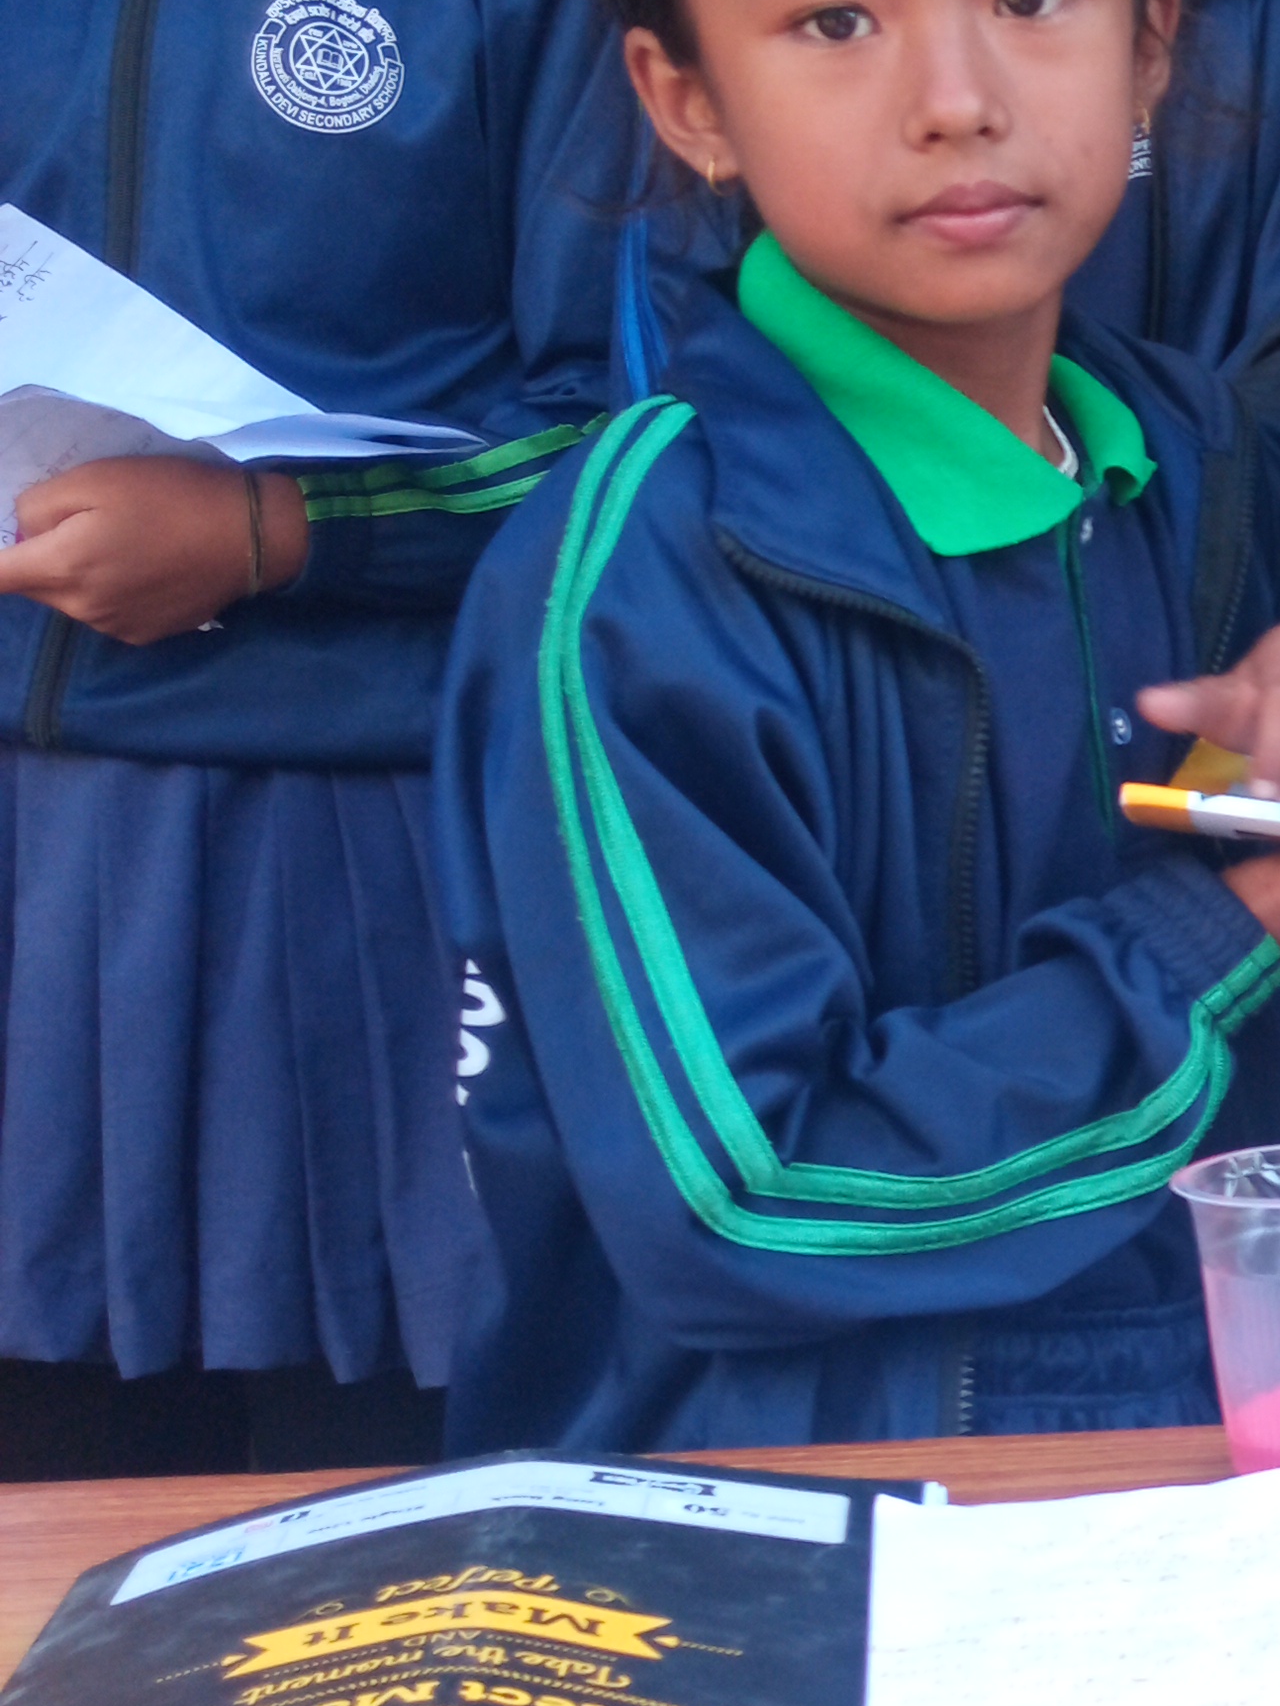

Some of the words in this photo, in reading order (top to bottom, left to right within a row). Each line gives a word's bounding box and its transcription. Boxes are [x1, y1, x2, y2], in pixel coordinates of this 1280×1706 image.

[255, 38, 277, 96] KUNDALA
[271, 92, 300, 118] DEVI
[298, 104, 376, 128] SECONDARY
[372, 65, 401, 111] SCHOOL
[376, 1565, 561, 1603] Perfect
[302, 1622, 360, 1646] It
[381, 1601, 605, 1637] Make
[404, 1629, 482, 1648] AND
[433, 1643, 509, 1666] the
[234, 1647, 423, 1706] moment
[515, 1649, 632, 1689] Take
